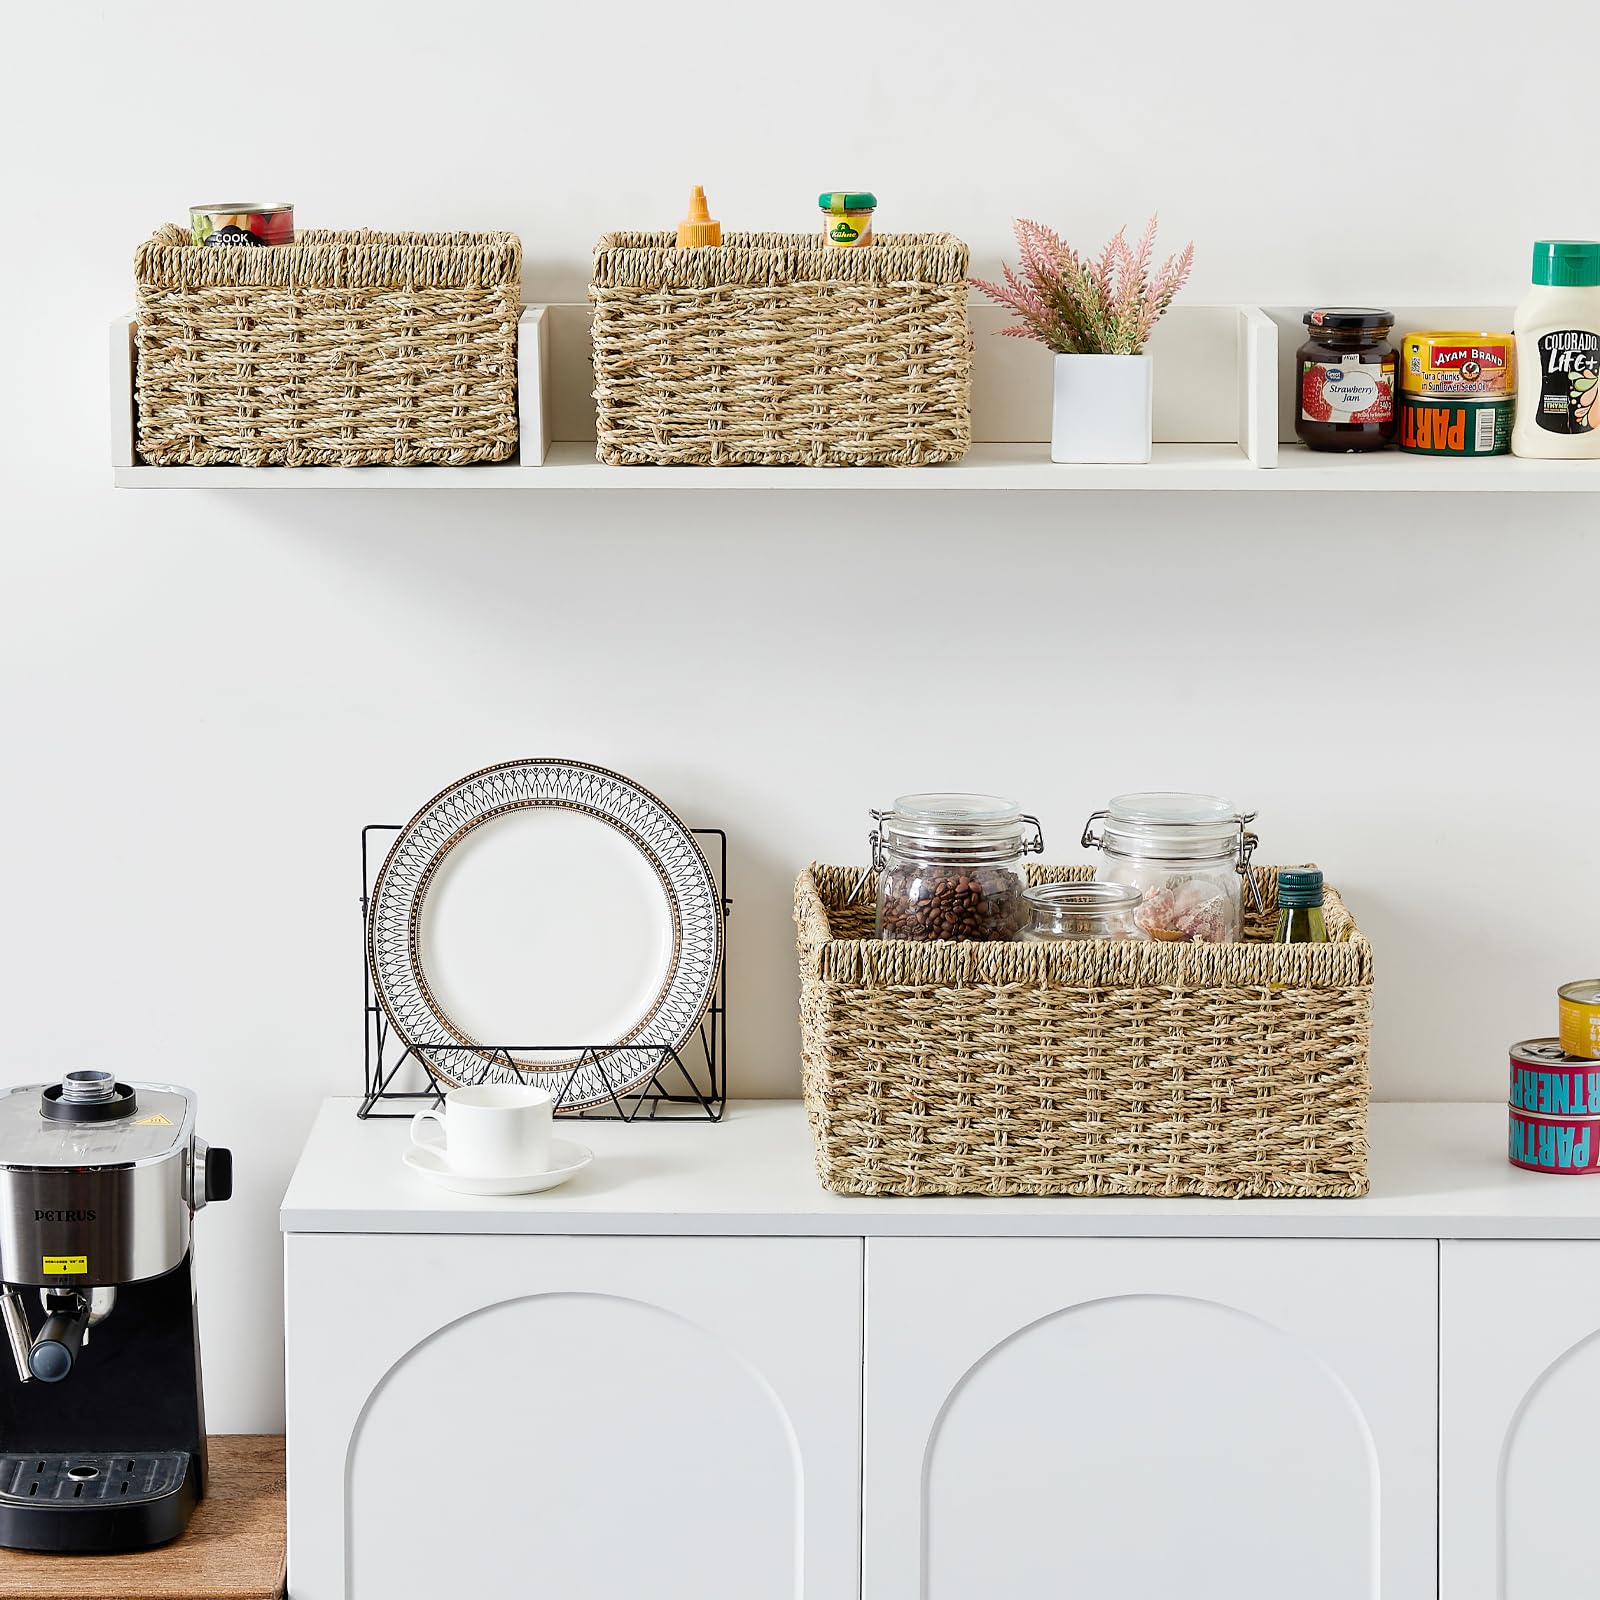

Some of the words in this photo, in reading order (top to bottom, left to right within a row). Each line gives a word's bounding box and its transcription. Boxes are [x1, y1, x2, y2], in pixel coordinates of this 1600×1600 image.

[216, 233, 249, 243] COOK
[1544, 332, 1597, 351] COLORADO
[1434, 350, 1468, 366] AYAM
[1471, 349, 1503, 366] BRAND
[1436, 372, 1460, 381] Chunks
[1329, 384, 1374, 395] Strawberry
[1428, 382, 1460, 391] Sunflower
[1461, 382, 1476, 391] Seed
[1477, 382, 1486, 391] Oil
[1341, 393, 1360, 402] Jam
